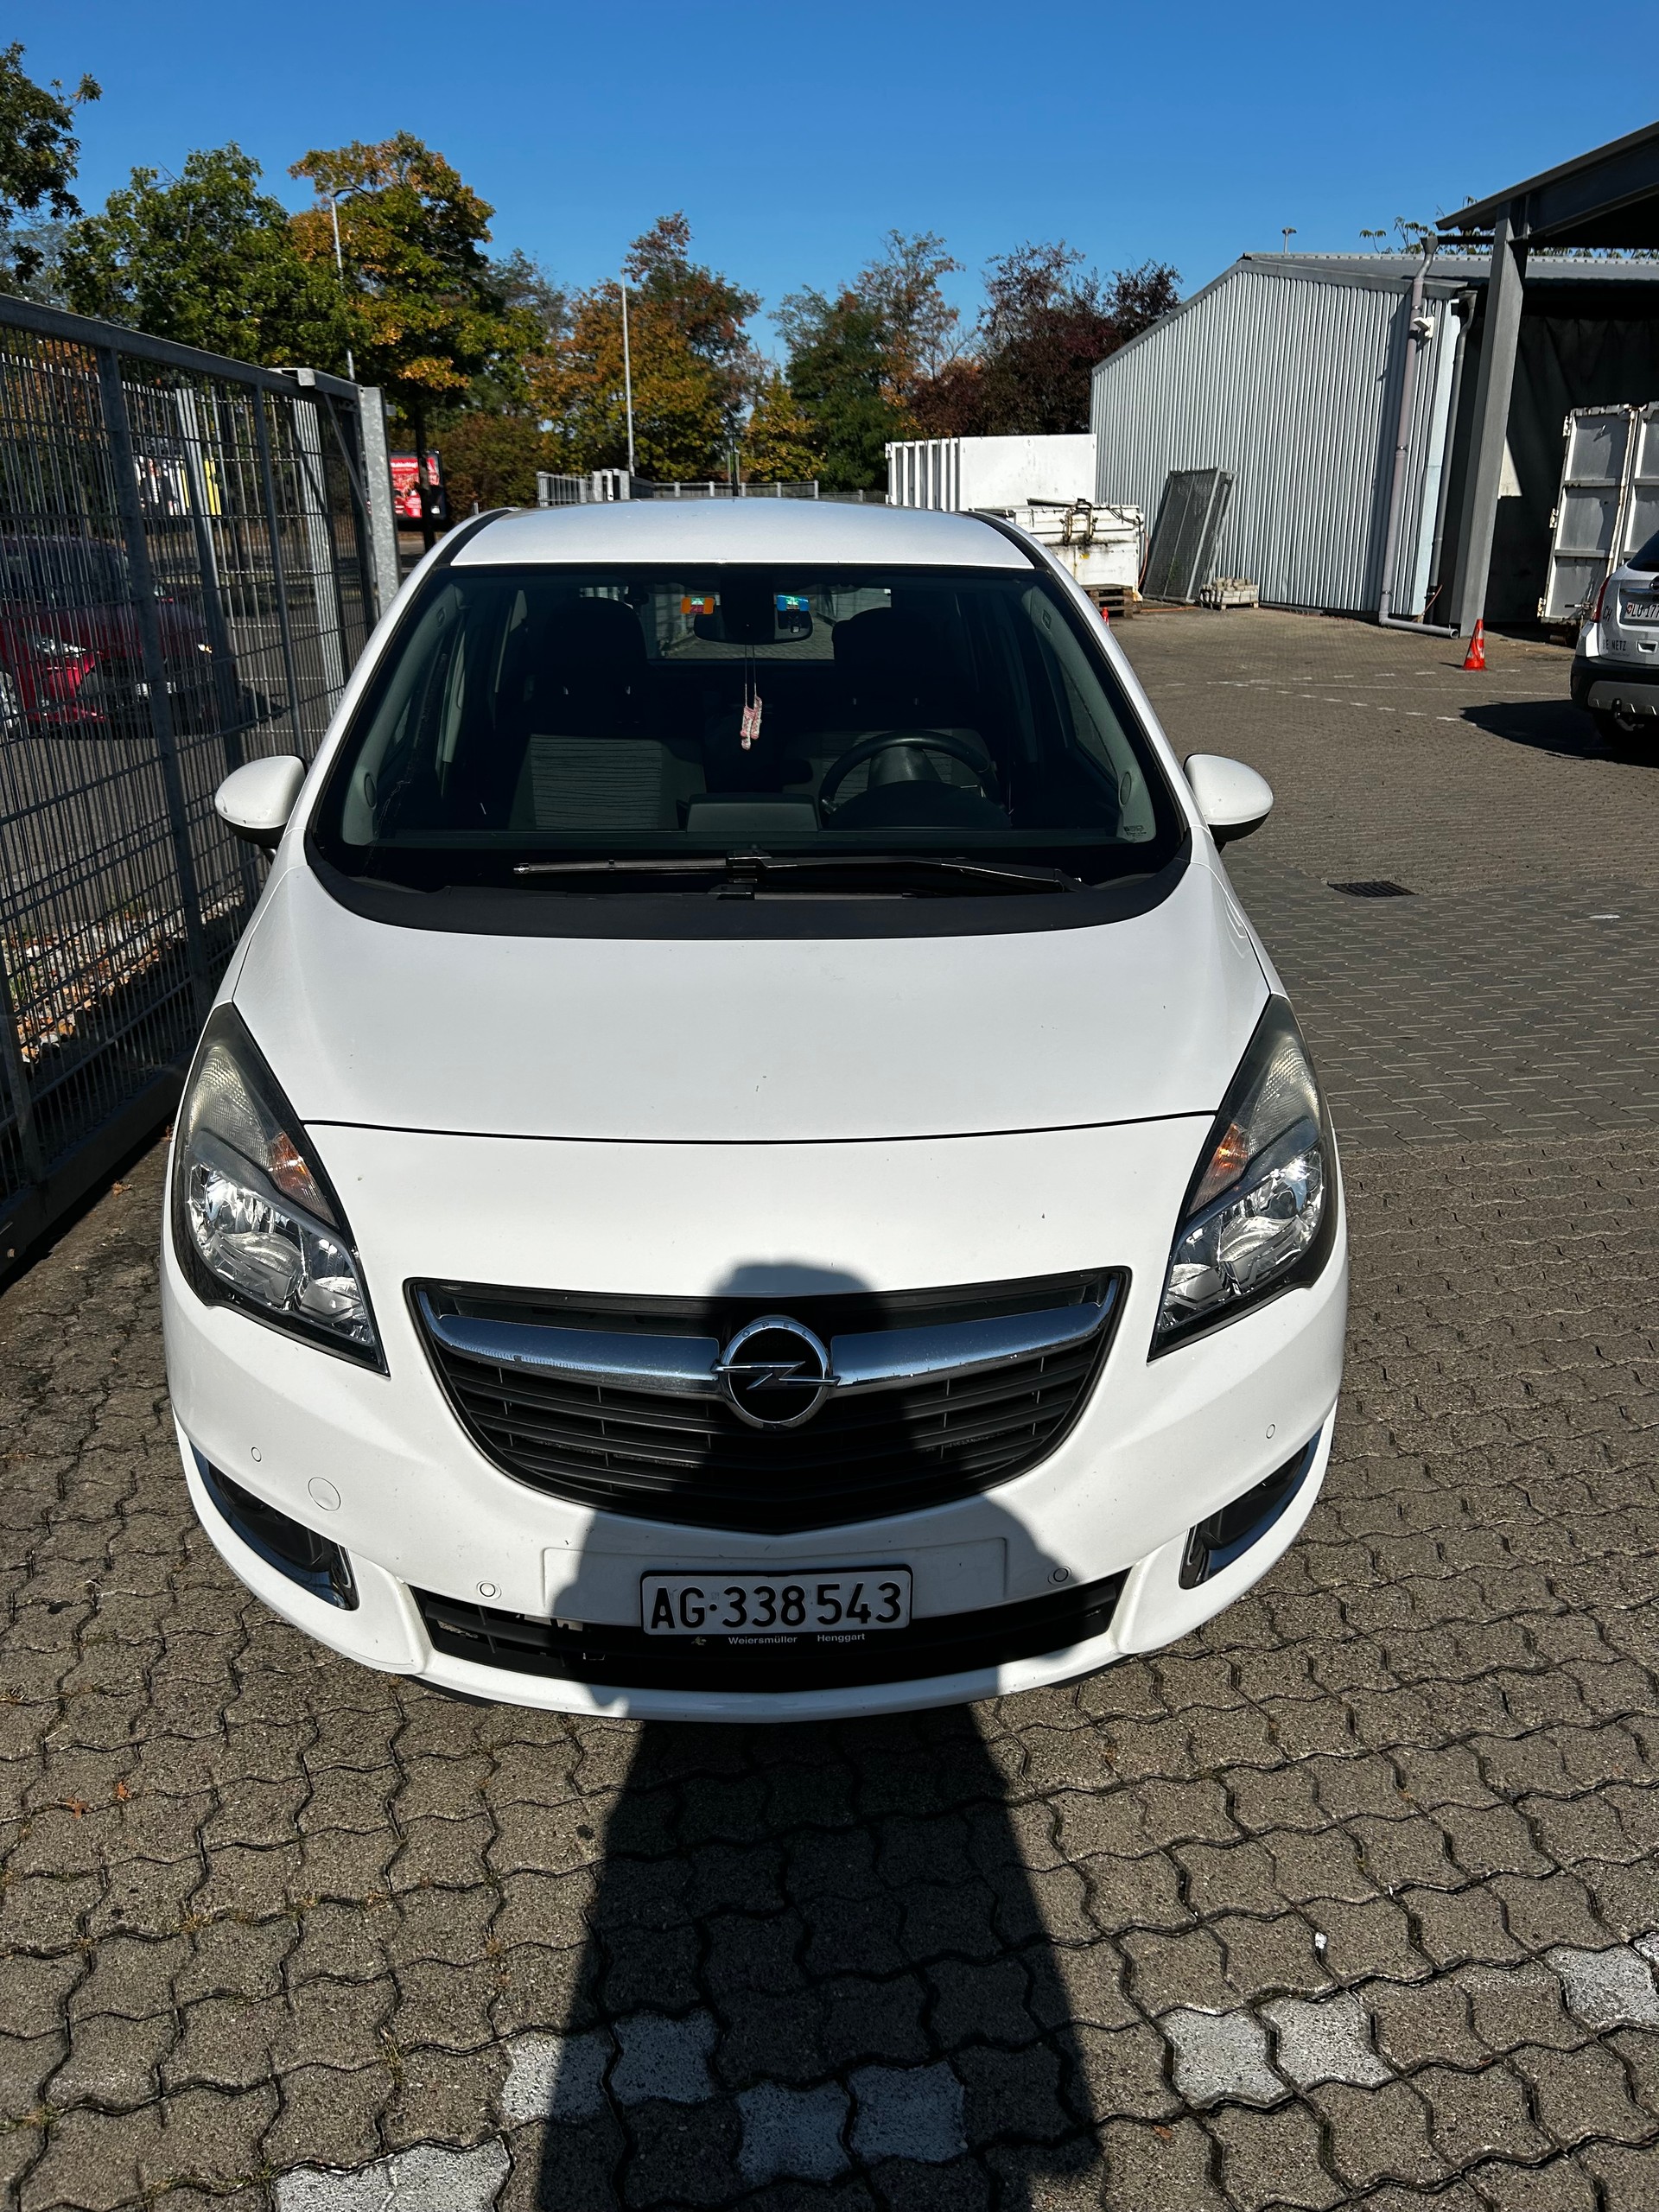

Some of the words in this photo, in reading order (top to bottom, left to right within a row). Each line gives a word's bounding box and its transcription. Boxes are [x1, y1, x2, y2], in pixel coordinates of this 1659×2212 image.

[1611, 639, 1627, 652] NETZ
[742, 1322, 808, 1338] OPEL
[728, 1635, 798, 1645] Weiersmüller
[817, 1632, 866, 1643] Henggart
